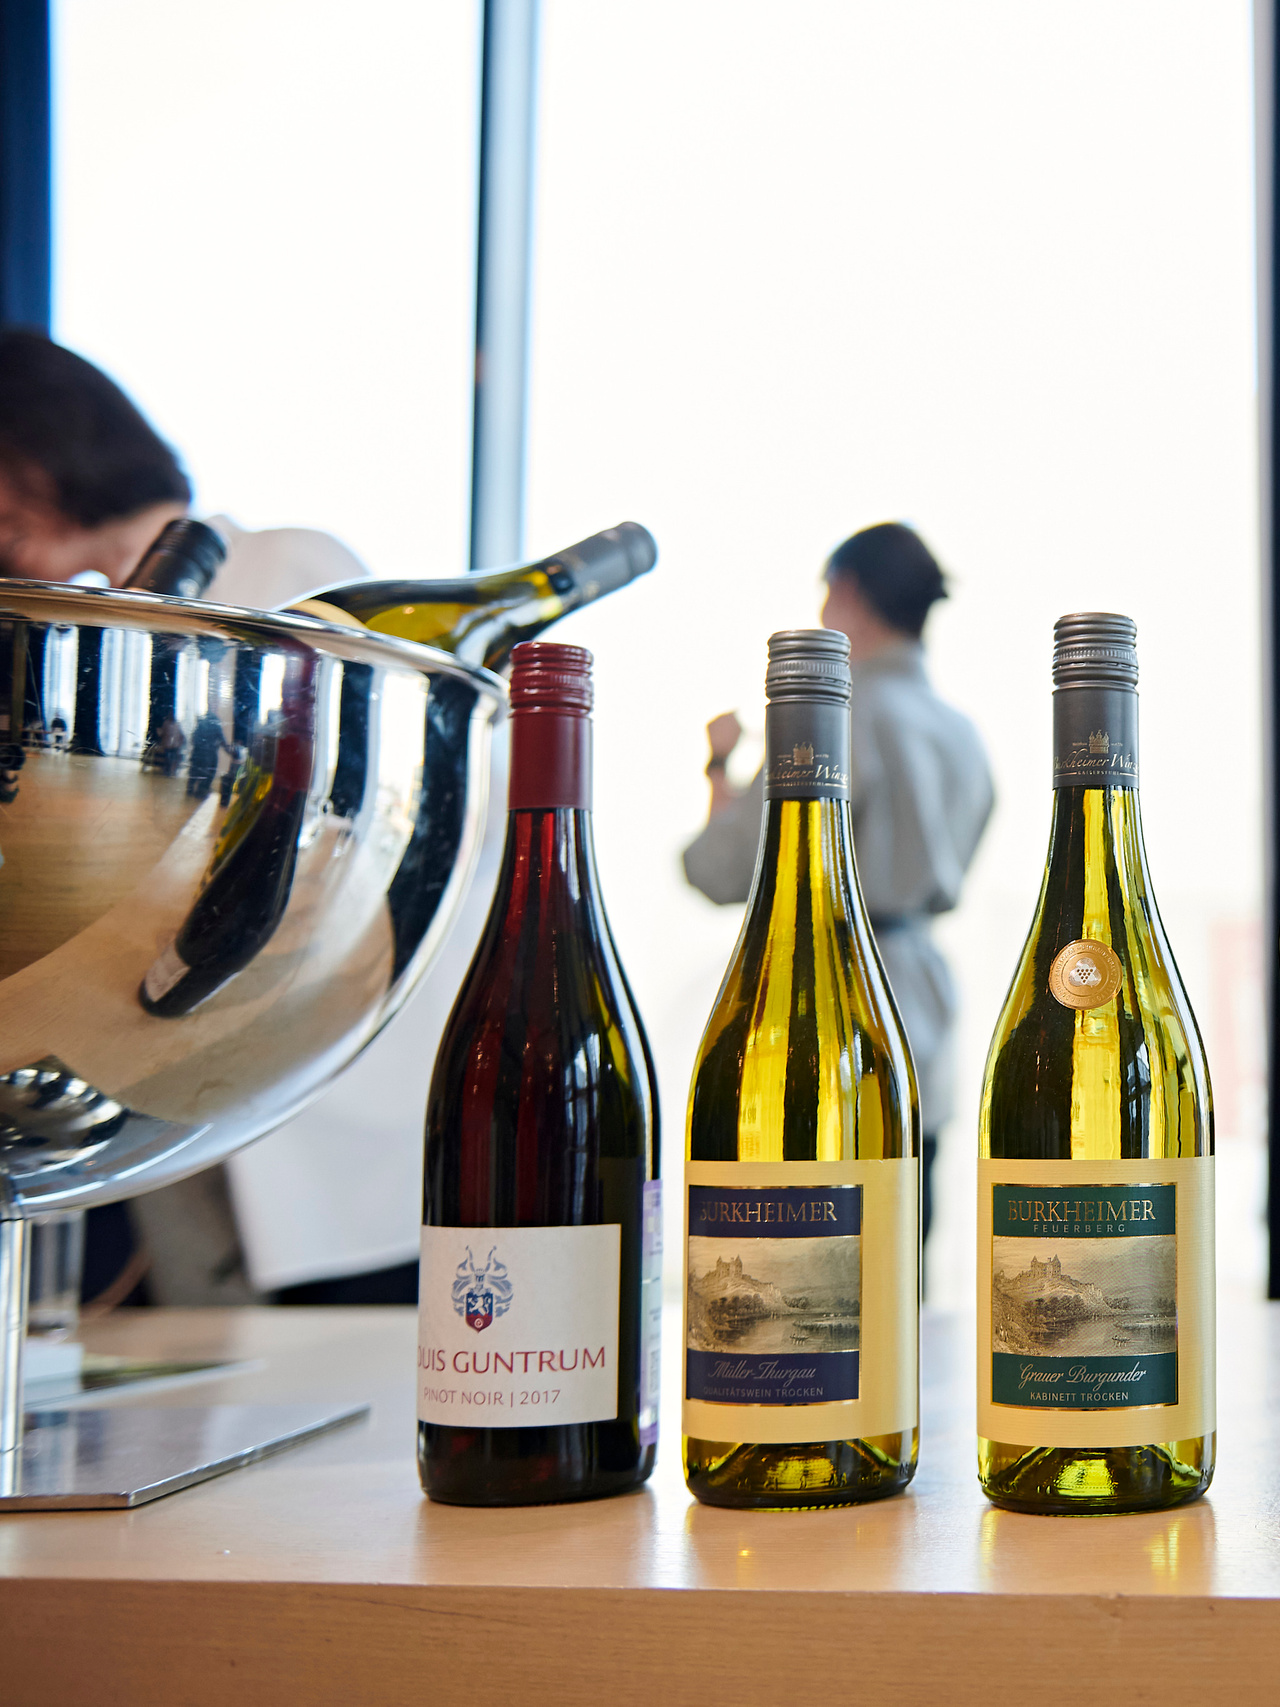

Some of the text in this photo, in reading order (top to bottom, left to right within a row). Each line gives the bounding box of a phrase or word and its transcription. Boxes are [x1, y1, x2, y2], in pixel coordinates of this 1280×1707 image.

[1008, 1199, 1157, 1223] BURKHEIMER
[1033, 1223, 1126, 1234] FEUERBERG
[452, 1346, 606, 1374] GUNTRUM
[707, 1359, 818, 1388] Müller-Thurgau
[1018, 1361, 1147, 1392] Grauer Burgunder
[424, 1386, 561, 1406] PINOT NOIR 2017
[775, 1386, 824, 1398] TROCKEN
[1030, 1391, 1129, 1402] KABINETT TROCKEN
